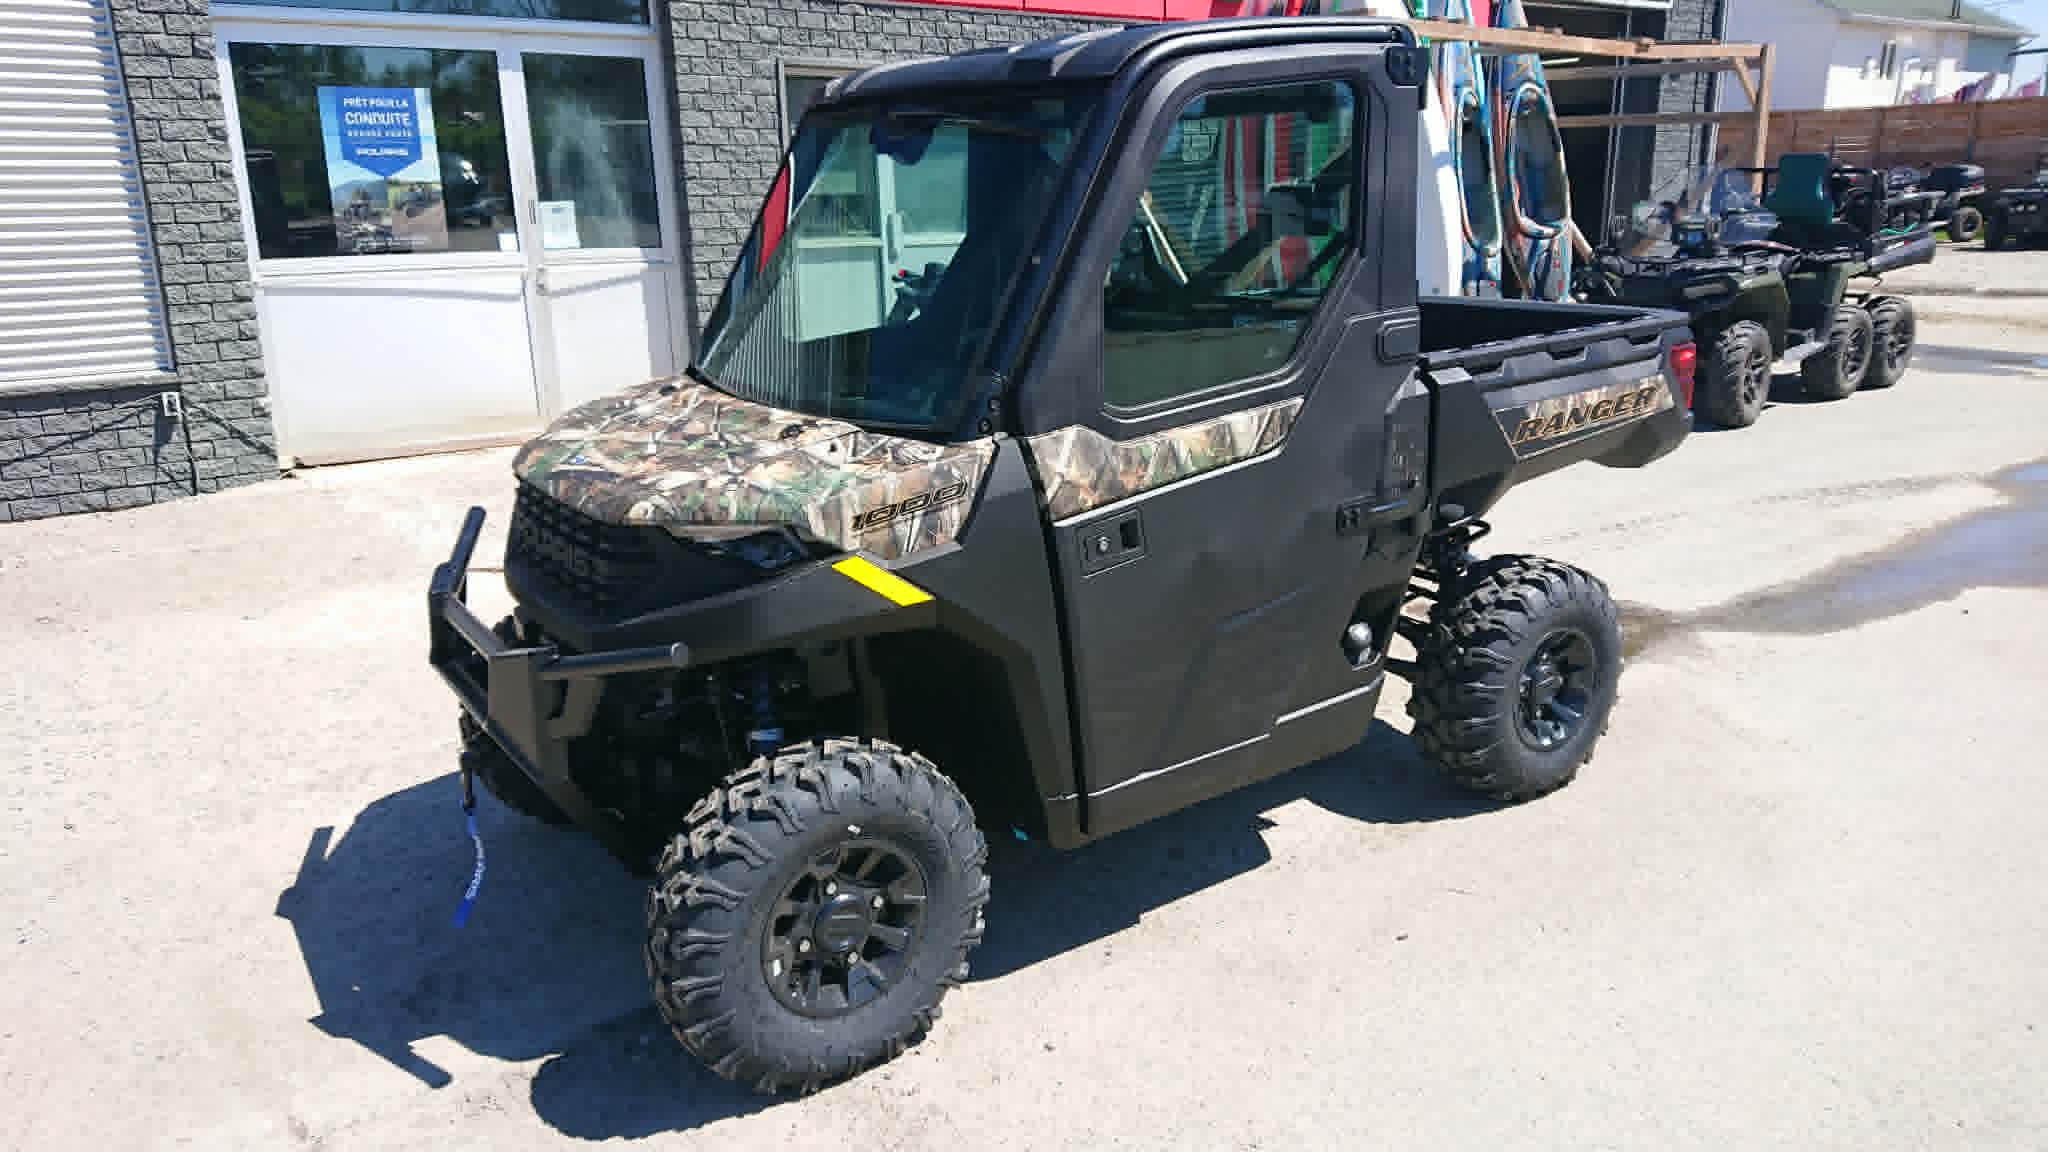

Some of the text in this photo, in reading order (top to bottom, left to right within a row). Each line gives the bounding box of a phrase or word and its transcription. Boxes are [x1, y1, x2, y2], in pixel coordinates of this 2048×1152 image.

[345, 111, 411, 127] CONDUITE
[1511, 386, 1658, 445] RANGER
[852, 480, 968, 530] 1000
